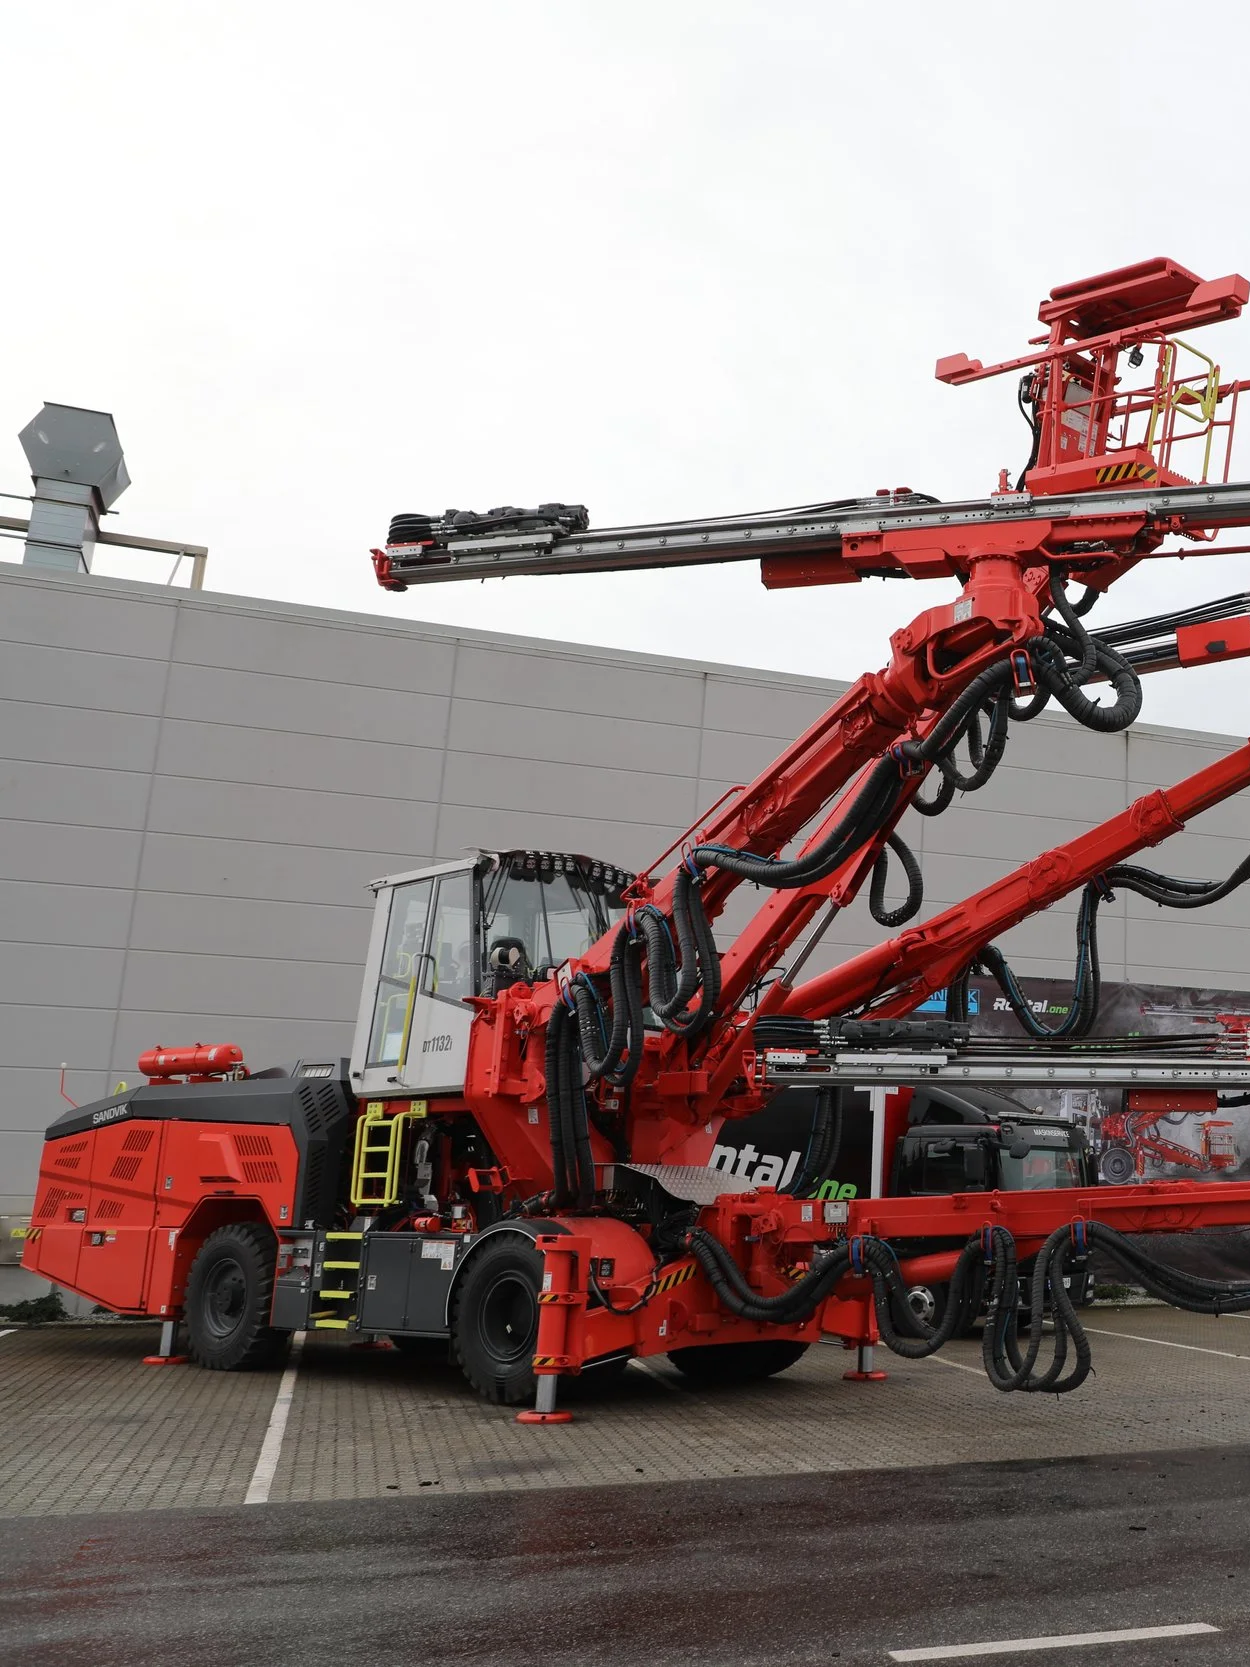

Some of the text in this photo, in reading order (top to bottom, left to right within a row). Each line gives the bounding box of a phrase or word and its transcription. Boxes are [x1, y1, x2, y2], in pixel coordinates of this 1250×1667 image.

[993, 998, 1068, 1013] Ral.one
[422, 1035, 453, 1053] DT1132i
[92, 1103, 128, 1124] SANDVIK
